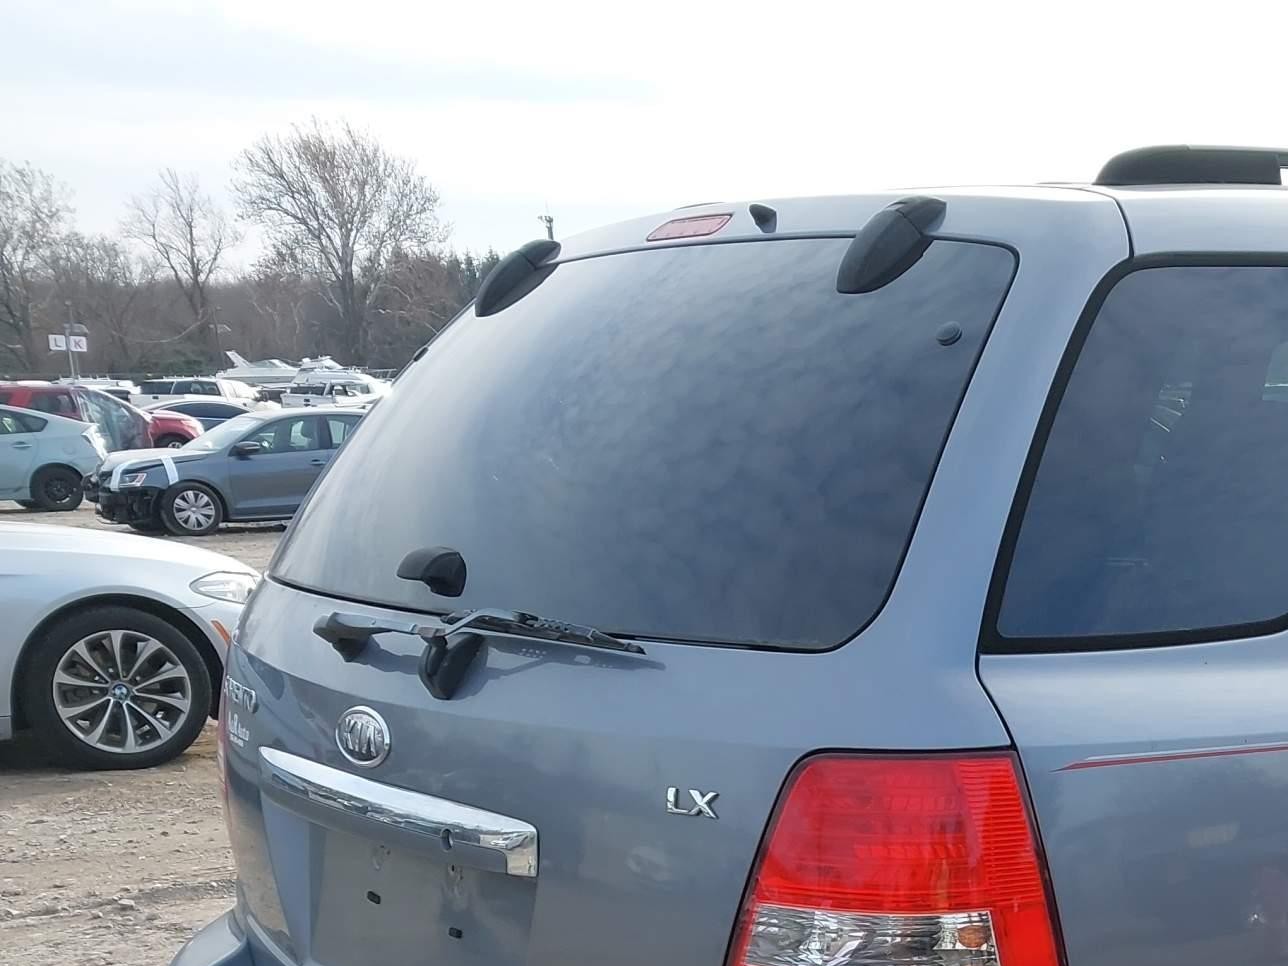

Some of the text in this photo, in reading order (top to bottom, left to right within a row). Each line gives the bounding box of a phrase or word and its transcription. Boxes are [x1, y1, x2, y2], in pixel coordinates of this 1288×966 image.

[54, 337, 62, 348] L
[73, 339, 84, 350] K
[666, 787, 718, 819] LX
